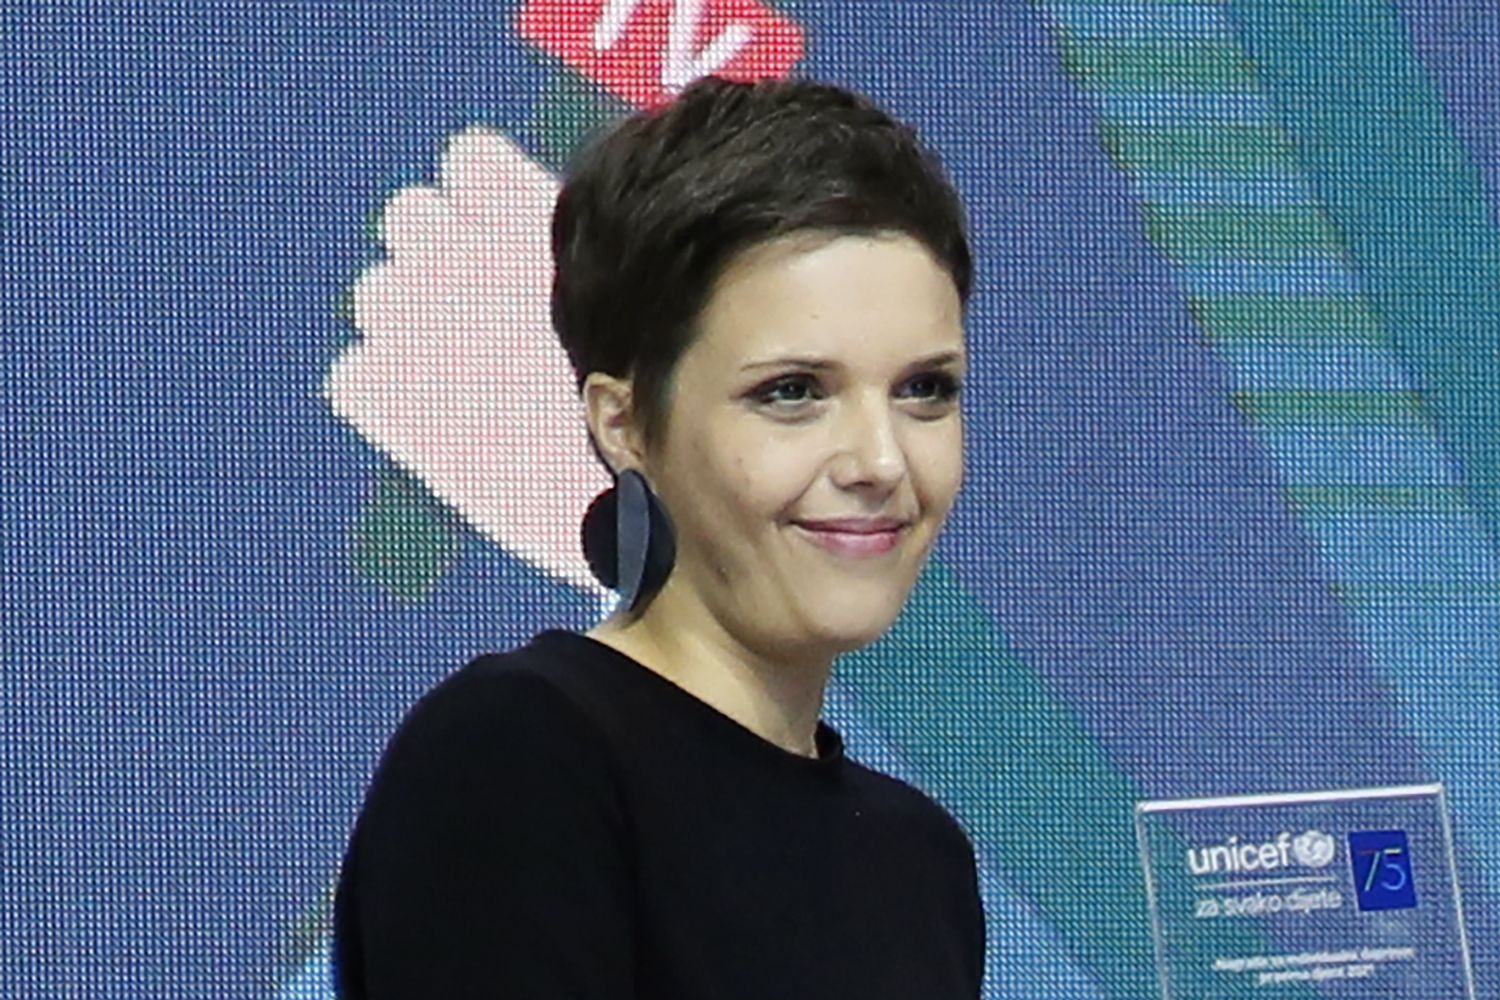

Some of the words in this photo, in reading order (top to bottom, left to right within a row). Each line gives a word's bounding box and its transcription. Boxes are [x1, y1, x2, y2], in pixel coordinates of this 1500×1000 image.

[1187, 832, 1291, 875] unicef
[1360, 848, 1407, 892] 75
[1194, 899, 1219, 918] za
[1224, 892, 1282, 917] svako
